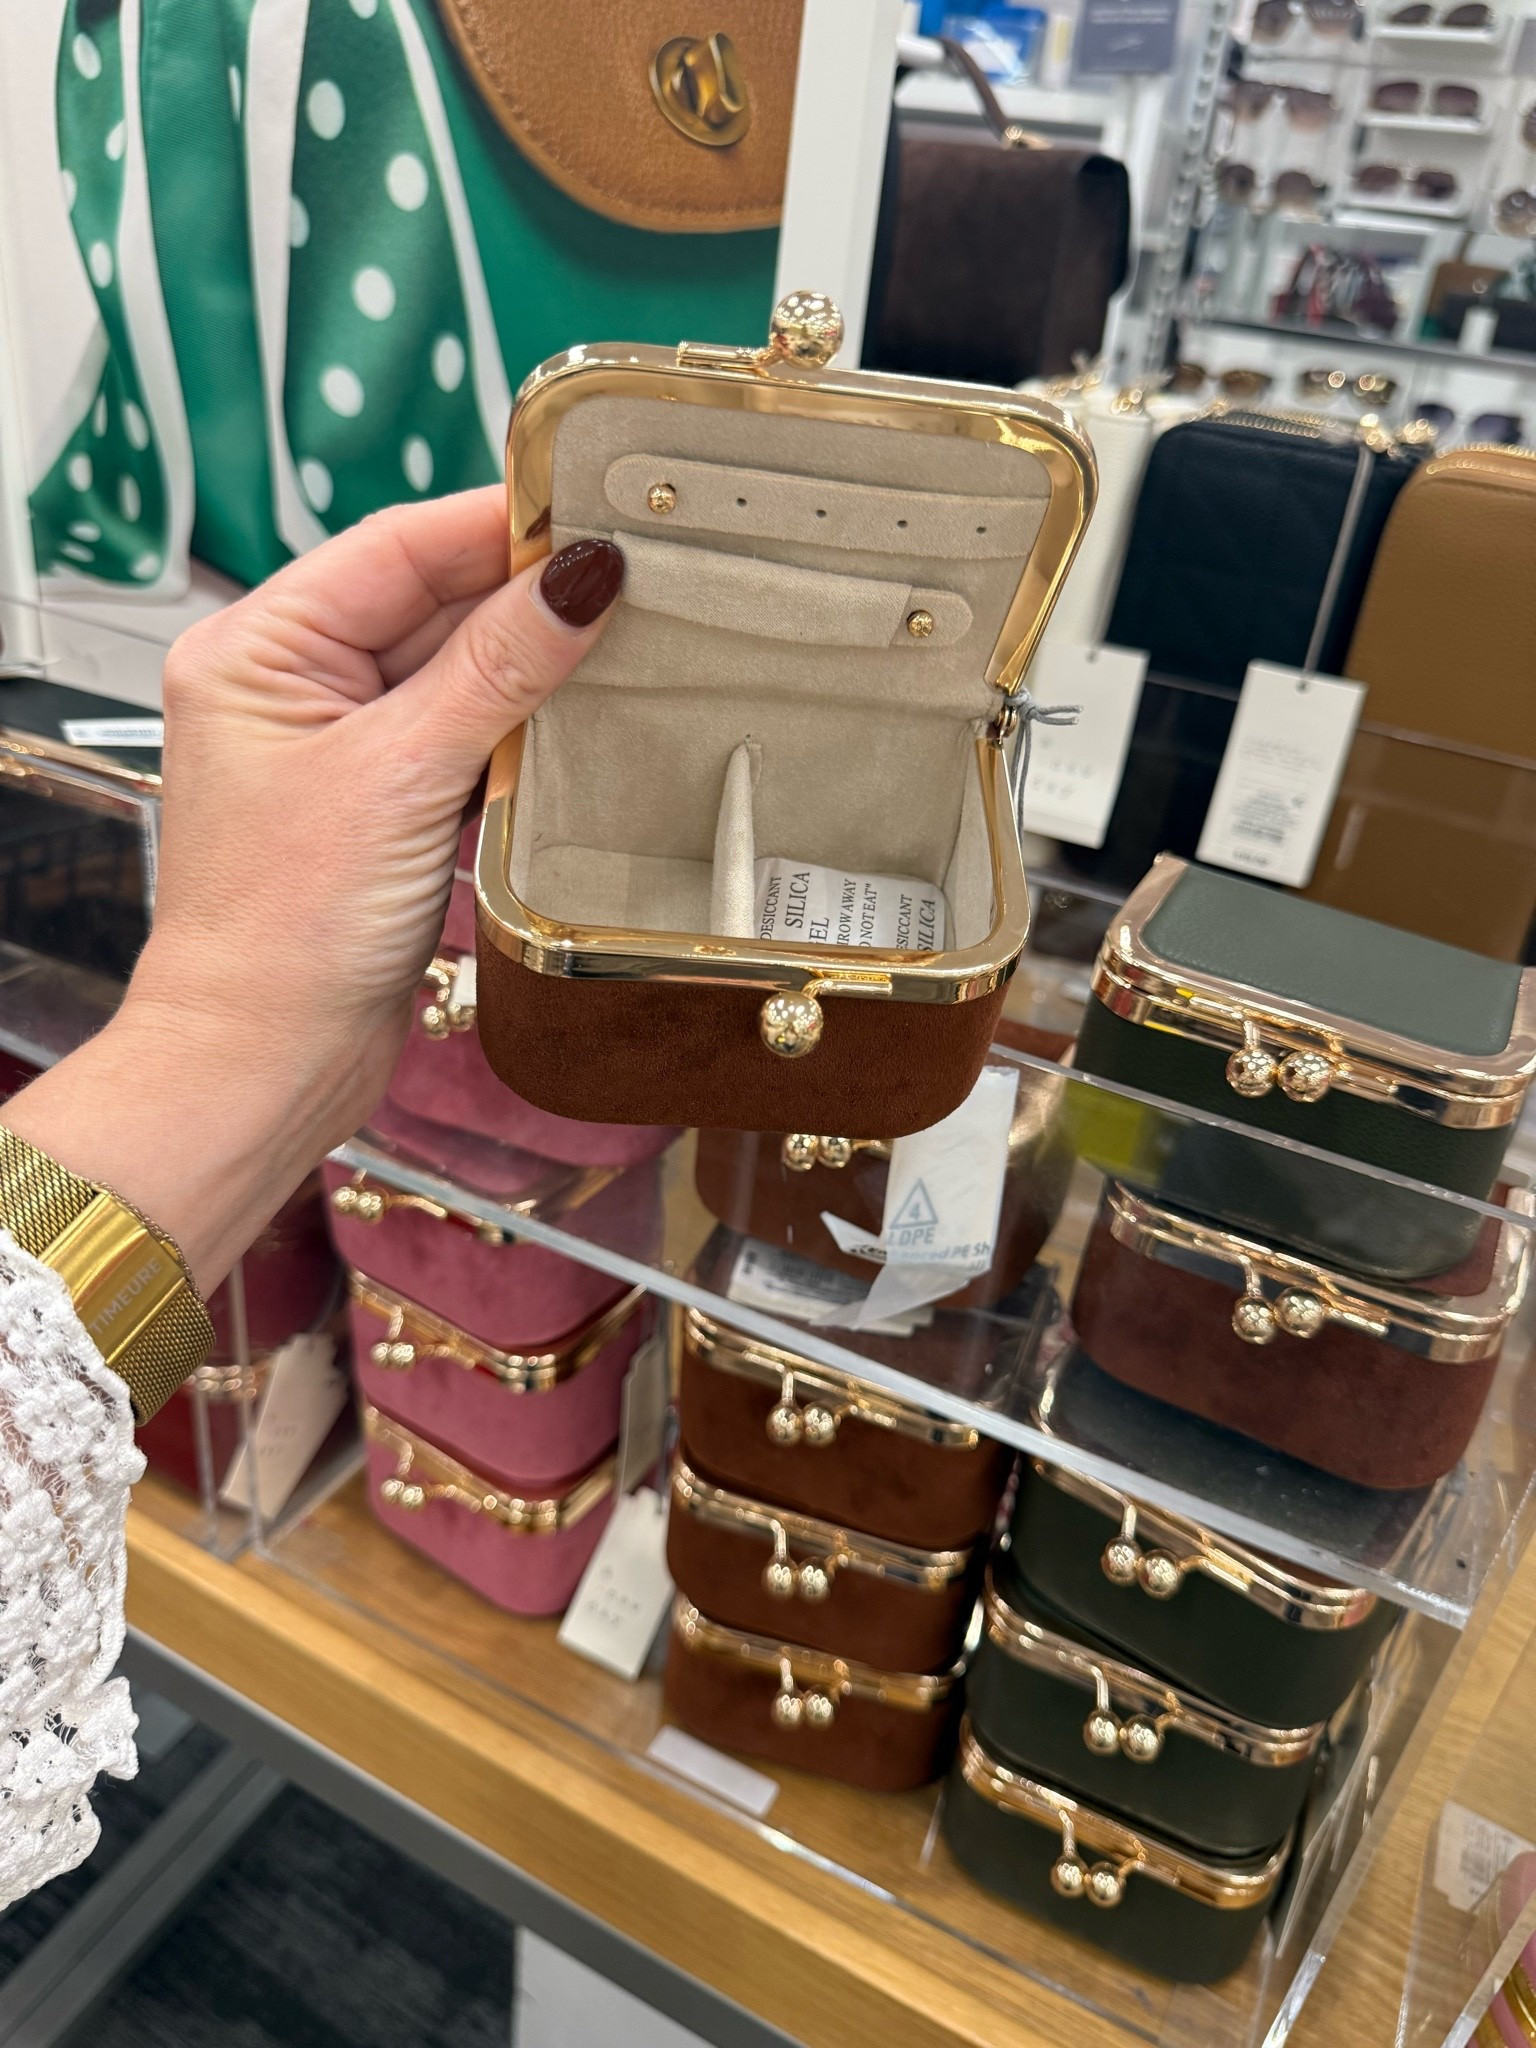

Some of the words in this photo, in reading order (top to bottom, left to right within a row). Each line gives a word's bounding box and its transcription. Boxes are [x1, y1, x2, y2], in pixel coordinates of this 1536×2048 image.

[760, 877, 782, 940] DESICCANT
[785, 872, 811, 929] SILICA
[841, 878, 857, 913] AWAY
[808, 917, 830, 945] EL
[860, 912, 875, 940] NOT
[917, 899, 936, 951] SILICA
[887, 1227, 934, 1247] LDPE
[89, 1257, 162, 1334] TIMEURE
